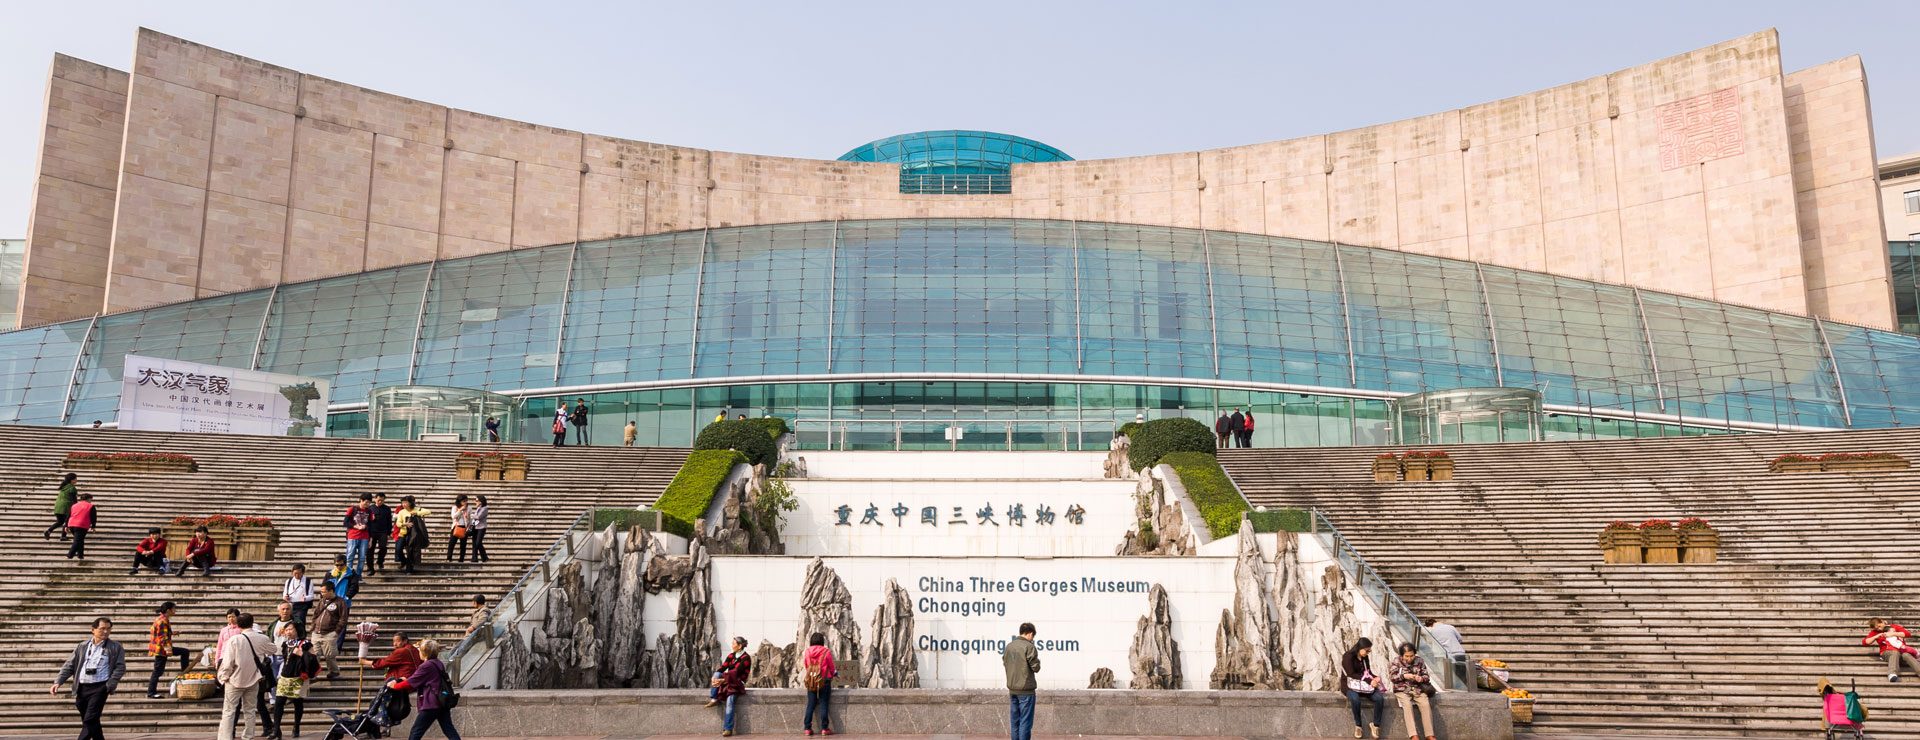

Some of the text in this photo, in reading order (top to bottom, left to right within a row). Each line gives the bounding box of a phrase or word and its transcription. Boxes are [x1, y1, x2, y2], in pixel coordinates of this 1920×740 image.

[138, 368, 230, 396] 大汉气象
[834, 502, 1086, 527] 重庆中国三峡博物馆
[919, 576, 1150, 596] China Three Gorges Museum
[918, 597, 1006, 617] Chongqing
[918, 635, 1079, 655] Chongqing seum
